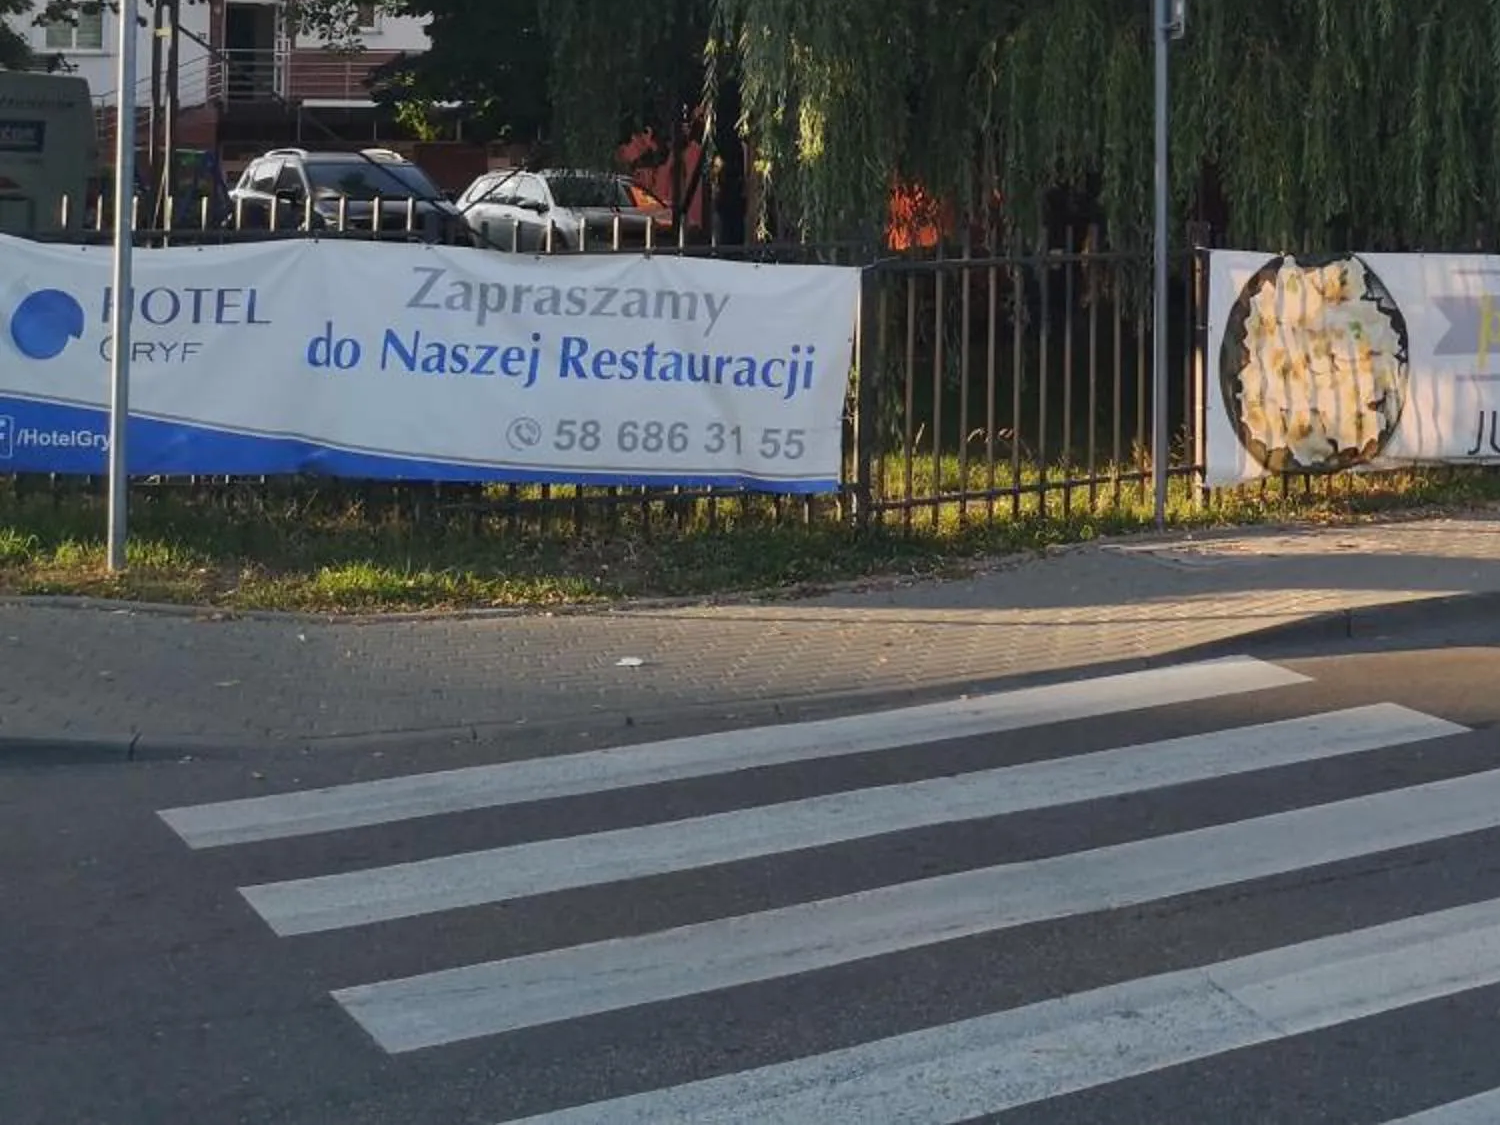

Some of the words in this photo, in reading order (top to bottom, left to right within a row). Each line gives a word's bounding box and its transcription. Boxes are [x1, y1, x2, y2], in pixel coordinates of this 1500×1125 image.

[406, 266, 731, 337] Zapraszamy
[306, 321, 361, 370] do
[381, 328, 541, 388] Naszej
[558, 336, 816, 399] Restauracji
[553, 420, 601, 452] 58
[617, 421, 689, 453] 686
[704, 422, 743, 455] 31
[759, 428, 805, 460] 55
